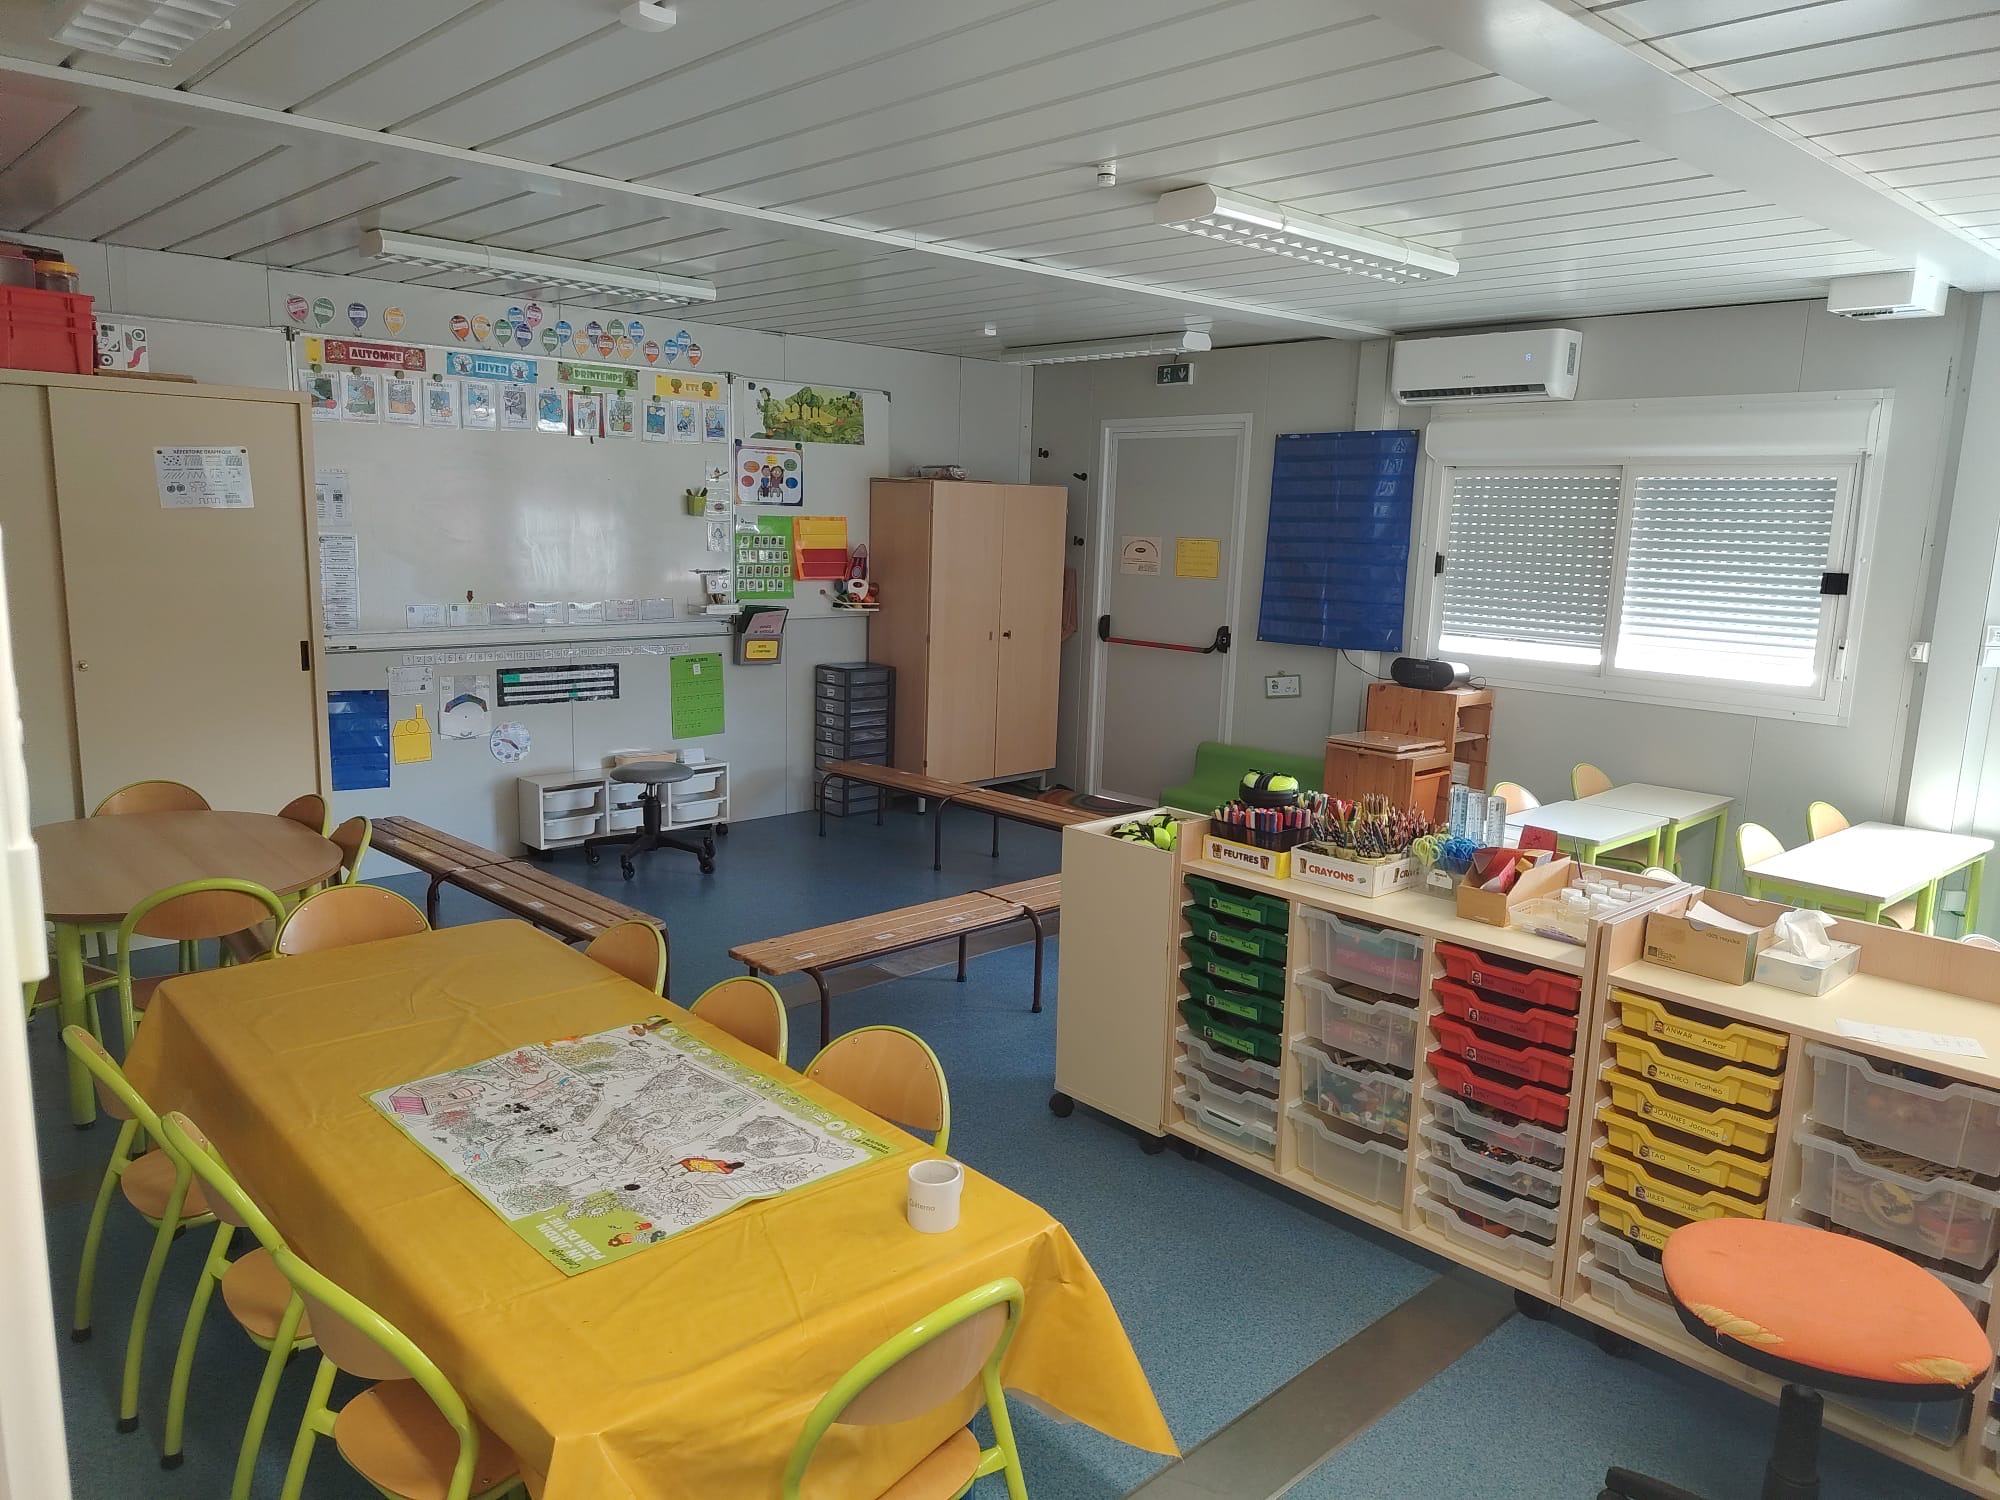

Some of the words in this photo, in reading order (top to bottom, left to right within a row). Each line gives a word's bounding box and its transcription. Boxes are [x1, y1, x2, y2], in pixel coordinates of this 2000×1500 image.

[351, 348, 402, 361] AUTOMNE
[477, 361, 508, 374] HIVER
[574, 368, 623, 383] PRINTEMPS
[1223, 849, 1259, 865] FEUTRES
[1308, 864, 1355, 883] CRAYONS
[1665, 1026, 1693, 1039] ANWAR
[1702, 1038, 1727, 1050] Anwar
[1653, 1108, 1686, 1125] JOANNES
[1688, 1122, 1719, 1138] Joannes
[1651, 1151, 1666, 1160] TAO
[1687, 1164, 1701, 1174] Tao
[1646, 1192, 1665, 1203] JULES
[548, 1217, 569, 1231] VIE
[535, 1222, 573, 1249] JARDIN
[562, 1228, 582, 1241] DE
[1641, 1231, 1663, 1244] HUGO
[565, 1248, 587, 1262] UN
[573, 1238, 607, 1261] PLEIN
